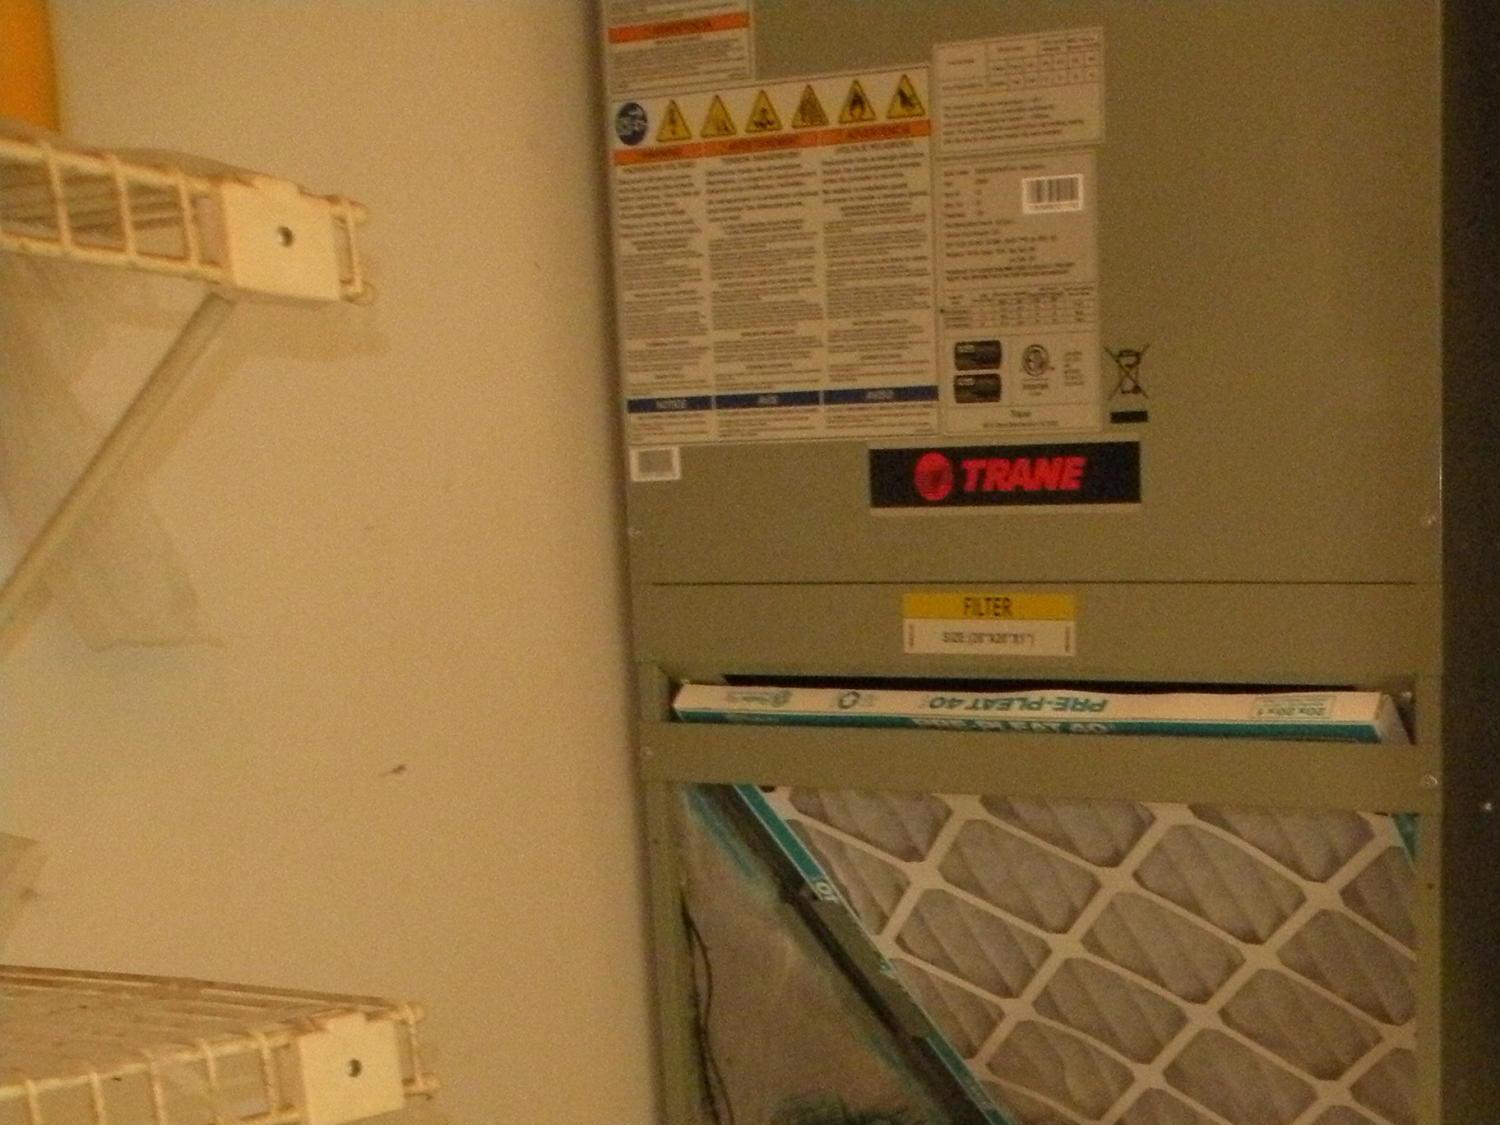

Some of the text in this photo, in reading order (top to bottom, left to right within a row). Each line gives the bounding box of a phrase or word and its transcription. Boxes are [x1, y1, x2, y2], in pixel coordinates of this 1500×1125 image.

[960, 455, 1087, 492] TRANE
[962, 597, 1014, 617] FILTER
[929, 692, 1110, 714] PRE-PLEAT 40
